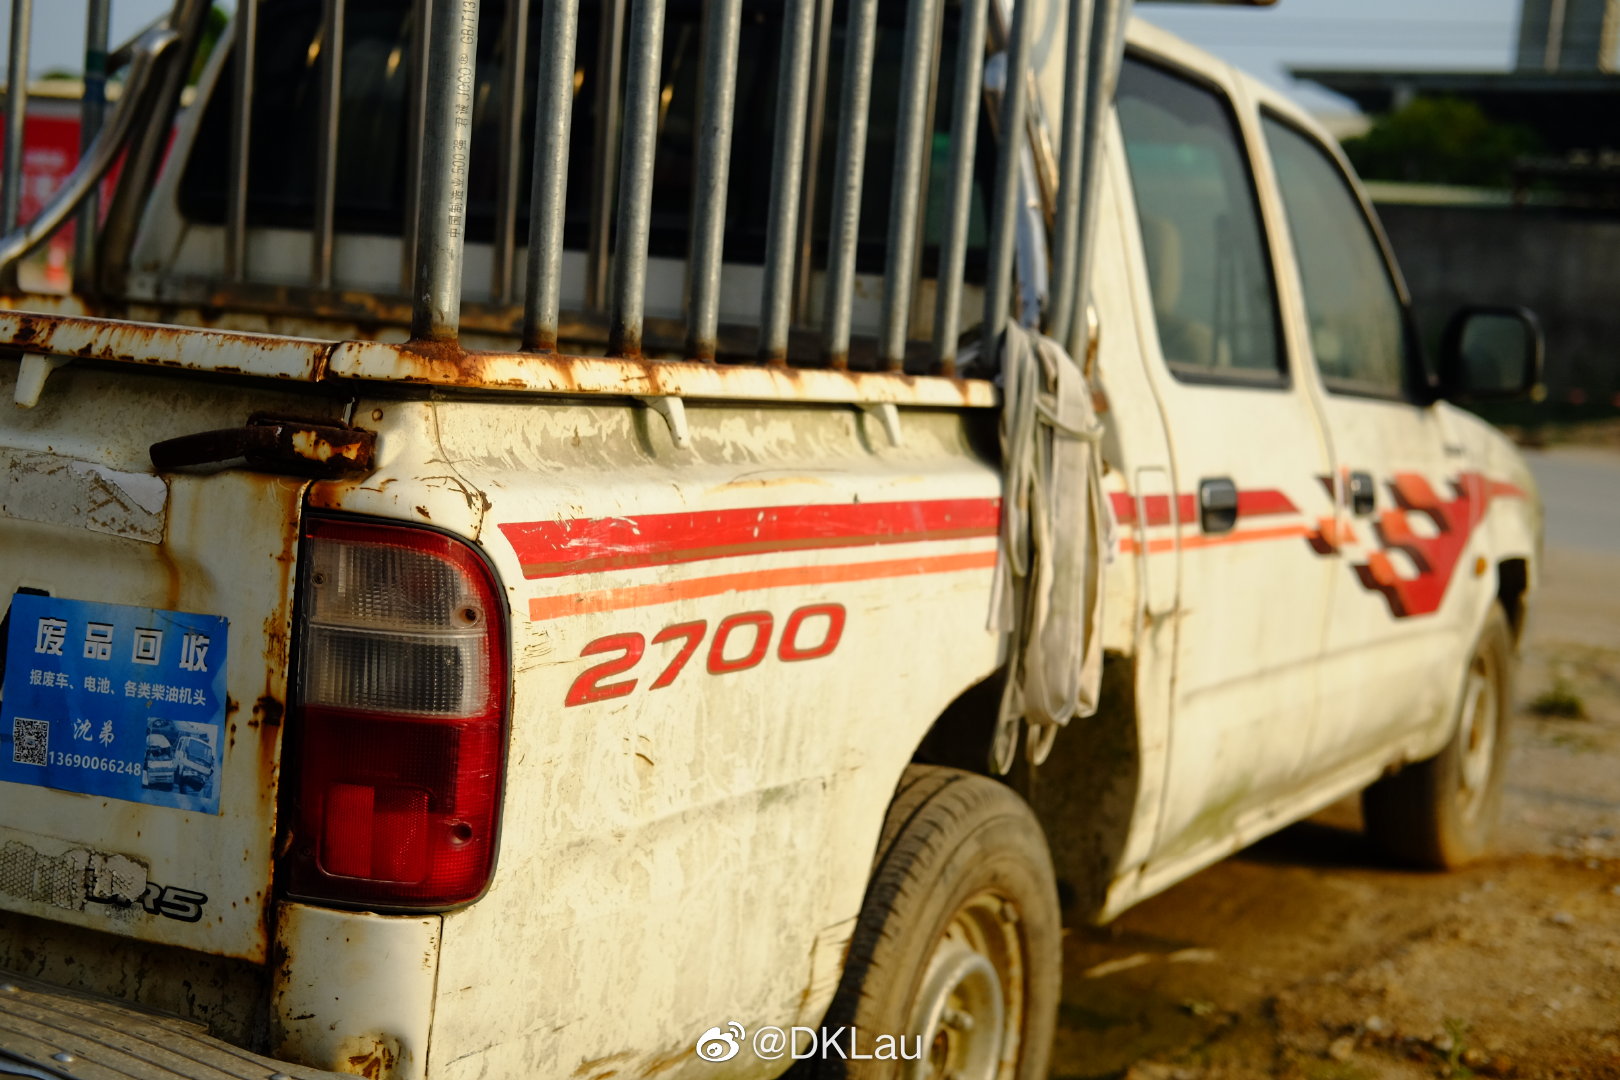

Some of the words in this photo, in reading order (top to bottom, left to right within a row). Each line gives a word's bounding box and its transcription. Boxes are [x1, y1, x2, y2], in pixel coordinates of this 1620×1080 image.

[34, 616, 210, 673] 废品回收
[564, 603, 846, 707] 2700
[48, 751, 142, 776] 13690066248
